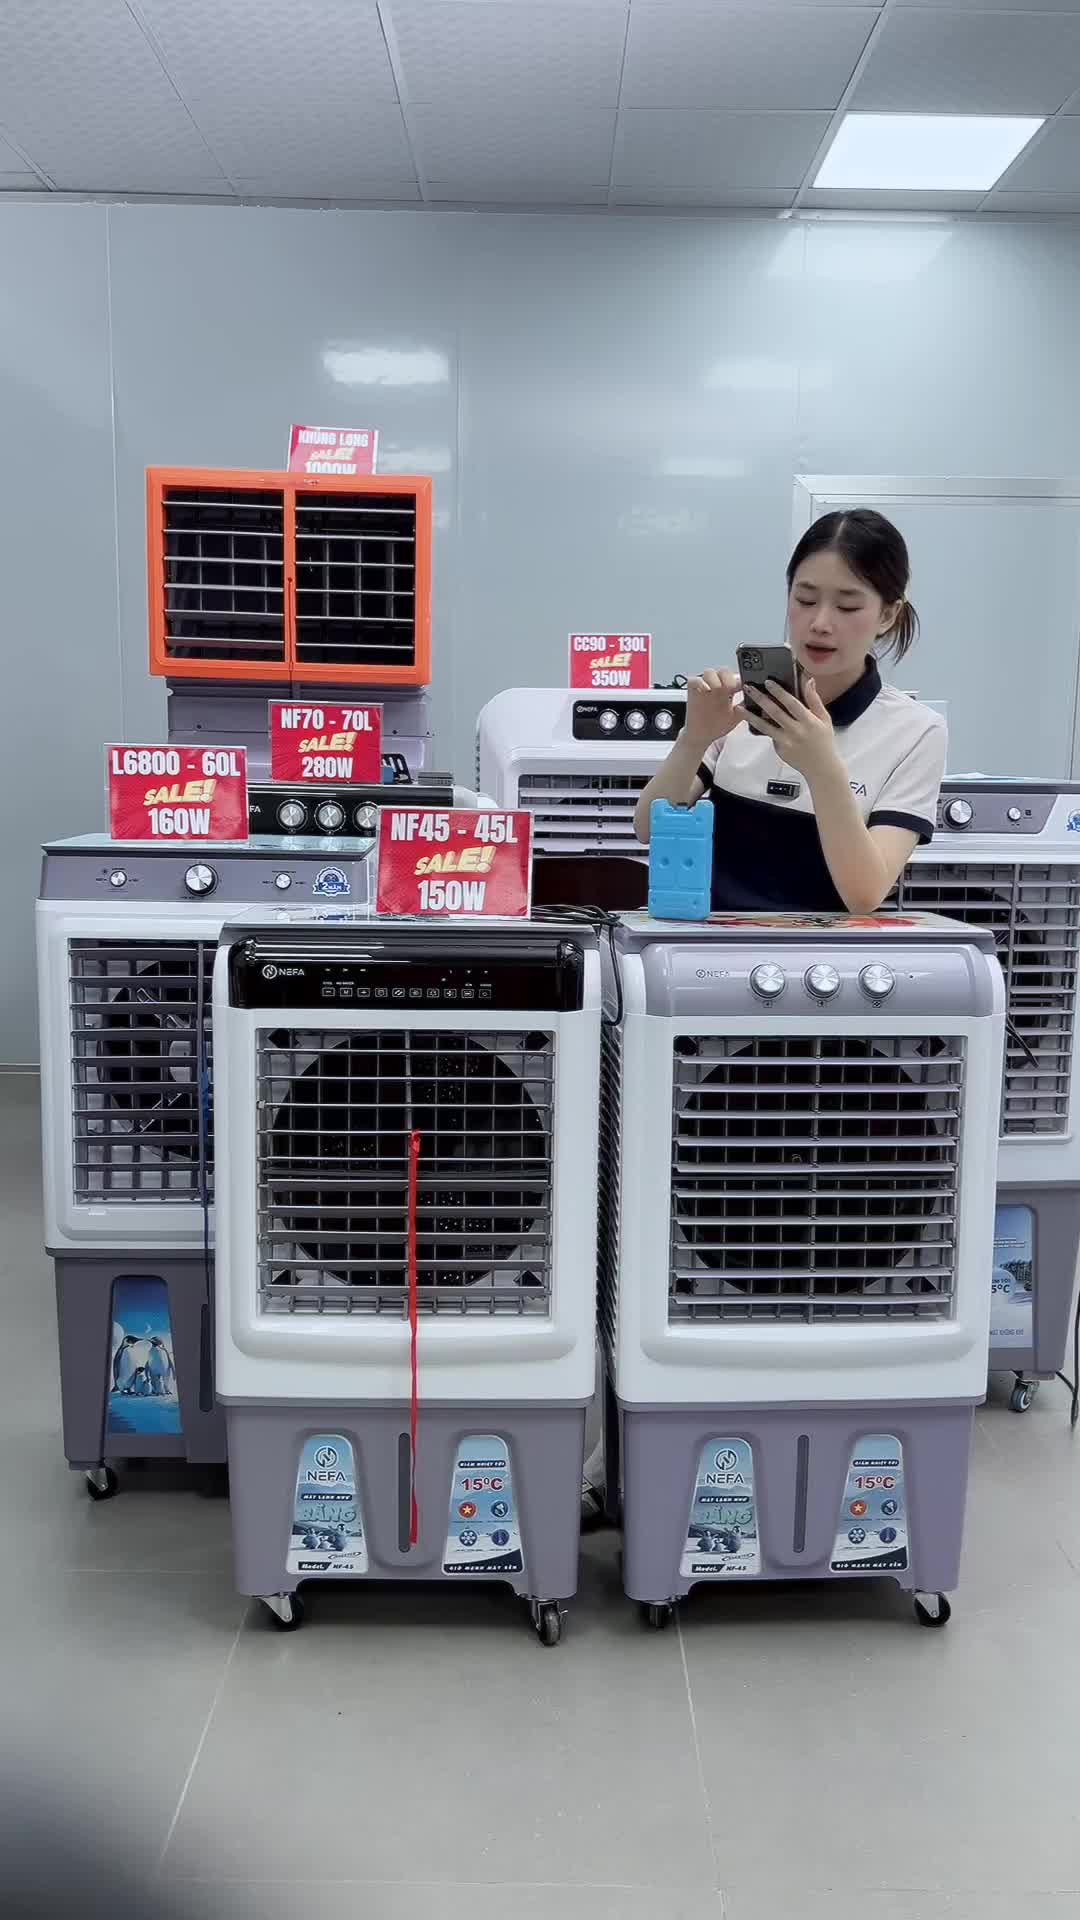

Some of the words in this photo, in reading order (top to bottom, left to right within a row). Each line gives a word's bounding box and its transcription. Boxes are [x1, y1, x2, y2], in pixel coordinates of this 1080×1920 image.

[574, 636, 606, 652] CC90
[618, 636, 647, 652] 130L
[589, 652, 632, 669] SALE!
[591, 669, 632, 686] 350W
[281, 708, 324, 730] NF70
[341, 709, 373, 731] 70L
[298, 731, 357, 753] SALE!
[112, 750, 180, 776] L6800
[202, 751, 241, 777] 60L
[302, 756, 353, 778] 280W
[143, 778, 217, 806] SALE!
[148, 807, 211, 835] 160W
[391, 812, 450, 842] NF45
[474, 814, 518, 844] 45L
[414, 845, 497, 876] SALE!
[417, 880, 487, 911] 150W
[278, 967, 305, 977] NEFA
[307, 1471, 346, 1481] NEFA
[706, 1473, 744, 1484] NEFA
